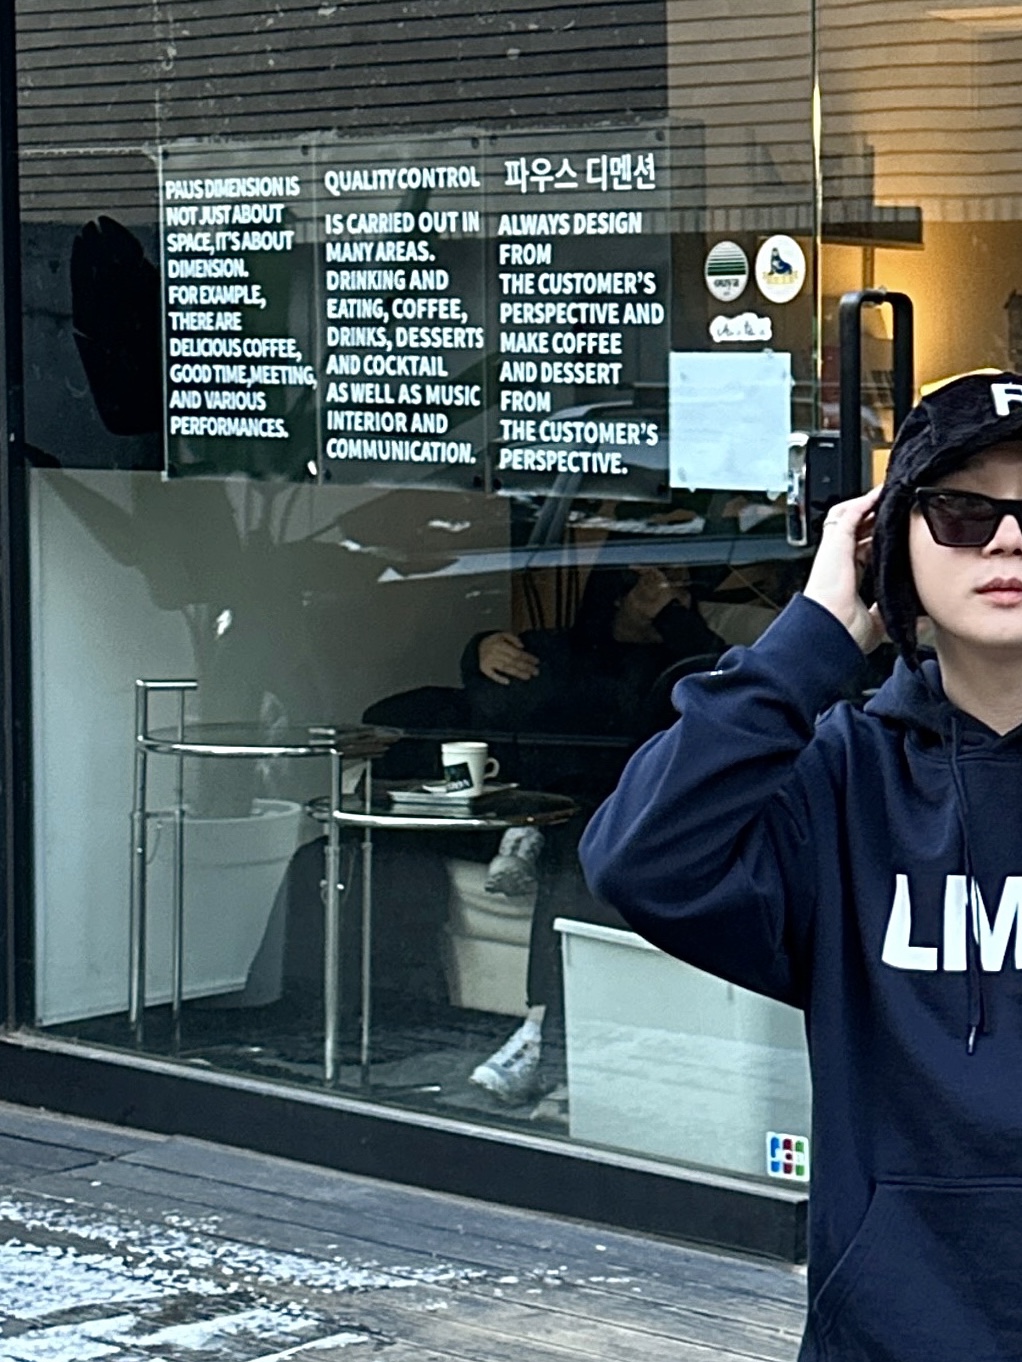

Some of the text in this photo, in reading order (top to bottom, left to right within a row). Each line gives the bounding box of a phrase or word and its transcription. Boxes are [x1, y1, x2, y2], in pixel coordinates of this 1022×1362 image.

[324, 166, 480, 196] QUALITY CONTROL
[504, 153, 656, 193] 파우스 디멘션
[205, 177, 283, 198] DIMENSION
[285, 176, 300, 196] IS
[166, 204, 284, 226] NOT JUST ABOUT
[326, 211, 479, 235] IS CARRIED OUT IN
[498, 212, 642, 236] ALWAYS DESIGN
[242, 231, 295, 250] ABOUT
[326, 240, 436, 262] MANY AREAS.
[499, 243, 551, 265] FROM
[168, 258, 249, 278] DIMENSION.
[326, 269, 449, 290] DRINKING AND
[499, 273, 535, 294] THE
[168, 285, 266, 309] FOR EXAMPLE,
[168, 312, 242, 330] THERE ARE
[327, 298, 468, 324] EATING, COFFEE,
[500, 302, 664, 324] PERSPECTIVE AND
[170, 338, 302, 362] DELICIOUS COFFEE,
[327, 326, 484, 352] DRINKS, DESSERTS
[500, 332, 622, 354] MAKE COFFEE
[170, 364, 212, 383] GOOD
[326, 355, 448, 377] AND COCKTAIL
[499, 361, 622, 384] AND DESSERT
[169, 390, 266, 411] AND VARIOUS
[326, 382, 481, 406] AS WELL AS MUSIC
[501, 390, 550, 412] FROM
[170, 416, 289, 438] PERFORMANCES.
[327, 410, 448, 434] INTERIOR AND
[500, 419, 536, 441] THE
[326, 438, 476, 464] COMMUNICATION.
[499, 448, 628, 475] PERSPECTIVE.
